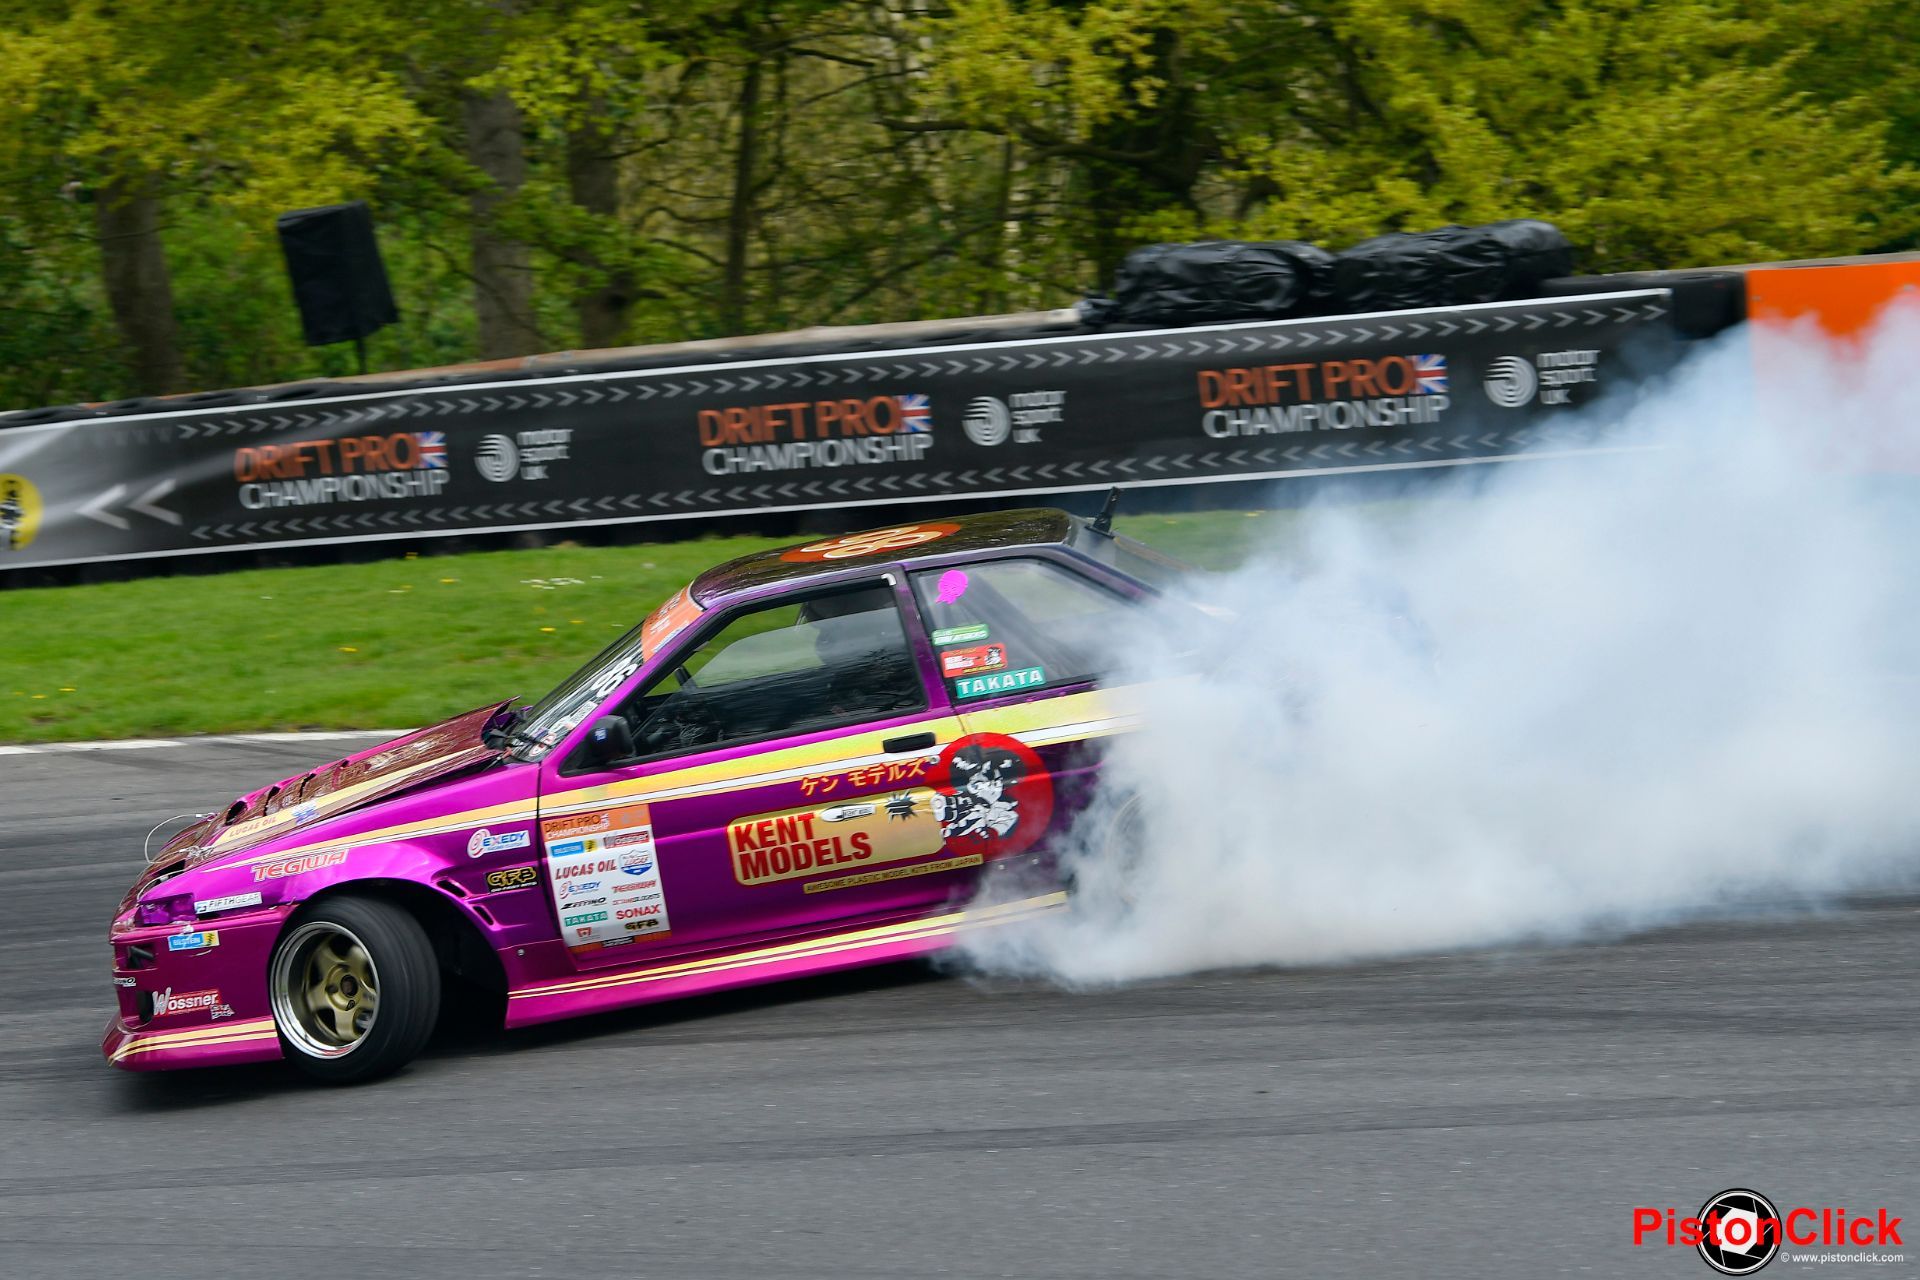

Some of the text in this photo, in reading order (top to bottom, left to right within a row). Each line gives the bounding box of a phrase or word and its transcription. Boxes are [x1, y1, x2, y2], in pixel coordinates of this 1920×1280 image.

[1197, 355, 1416, 409] DRIFT PRO
[698, 395, 900, 447] DRIFT PRO
[1202, 394, 1451, 439] CHAMPIONSHIP
[233, 432, 420, 483] DRIFT PRO
[702, 432, 934, 476] CHAMPIONSHIP
[238, 469, 450, 510] CHAMPIONSHIP
[957, 669, 1044, 695] TAKATA
[229, 816, 278, 838] LUCAS OIL
[483, 831, 527, 847] EXEDY
[544, 813, 601, 833] DRIFT PRO
[734, 812, 816, 853] KENT
[252, 849, 348, 882] TEGIWA
[555, 863, 594, 880] LUCAS
[597, 857, 618, 873] OIL
[738, 830, 873, 881] MODELS
[882, 868, 910, 881] MODEL
[929, 860, 953, 871] FROM
[615, 903, 661, 921] SONAX
